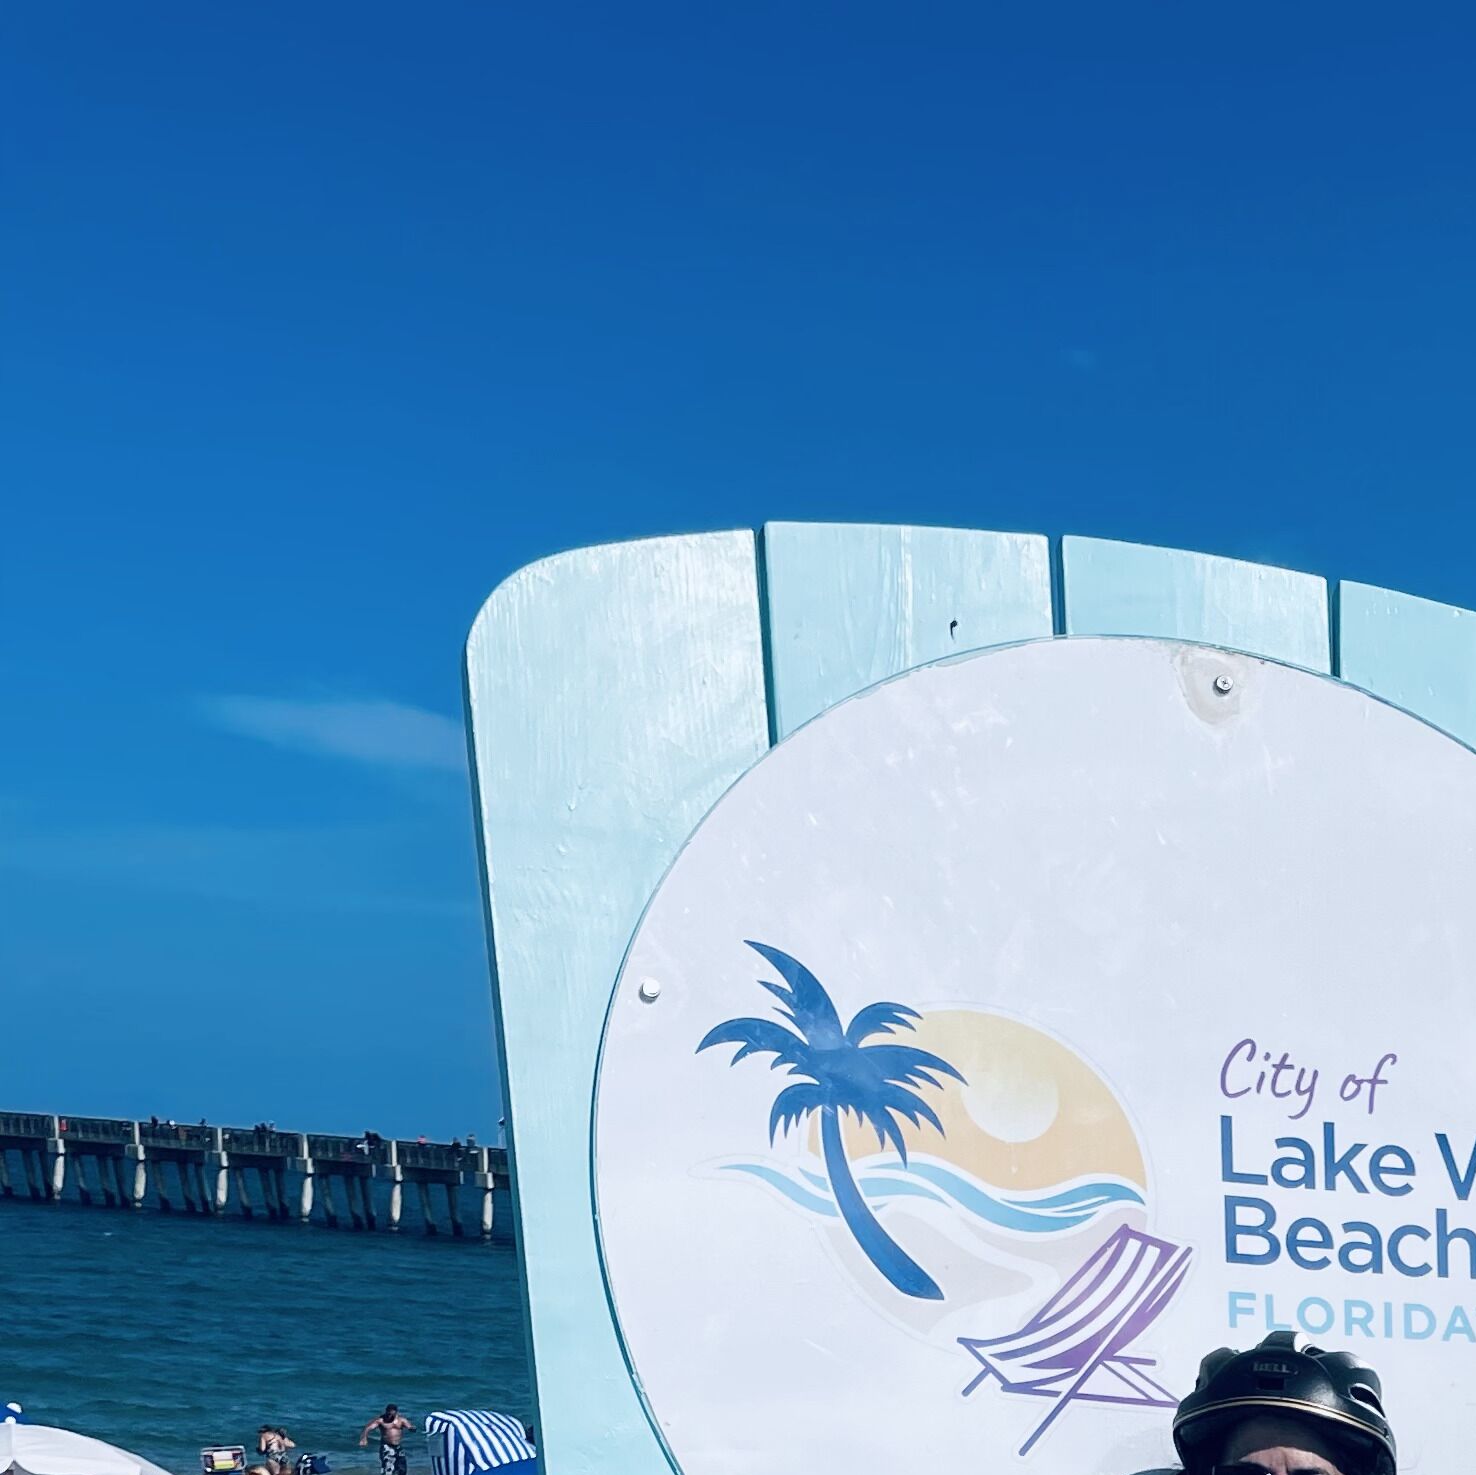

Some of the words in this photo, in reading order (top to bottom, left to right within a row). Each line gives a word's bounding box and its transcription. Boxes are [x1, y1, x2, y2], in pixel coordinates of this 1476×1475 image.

[1219, 1037, 1319, 1120] City
[1339, 1053, 1398, 1115] of
[1220, 1114, 1416, 1197] Lake
